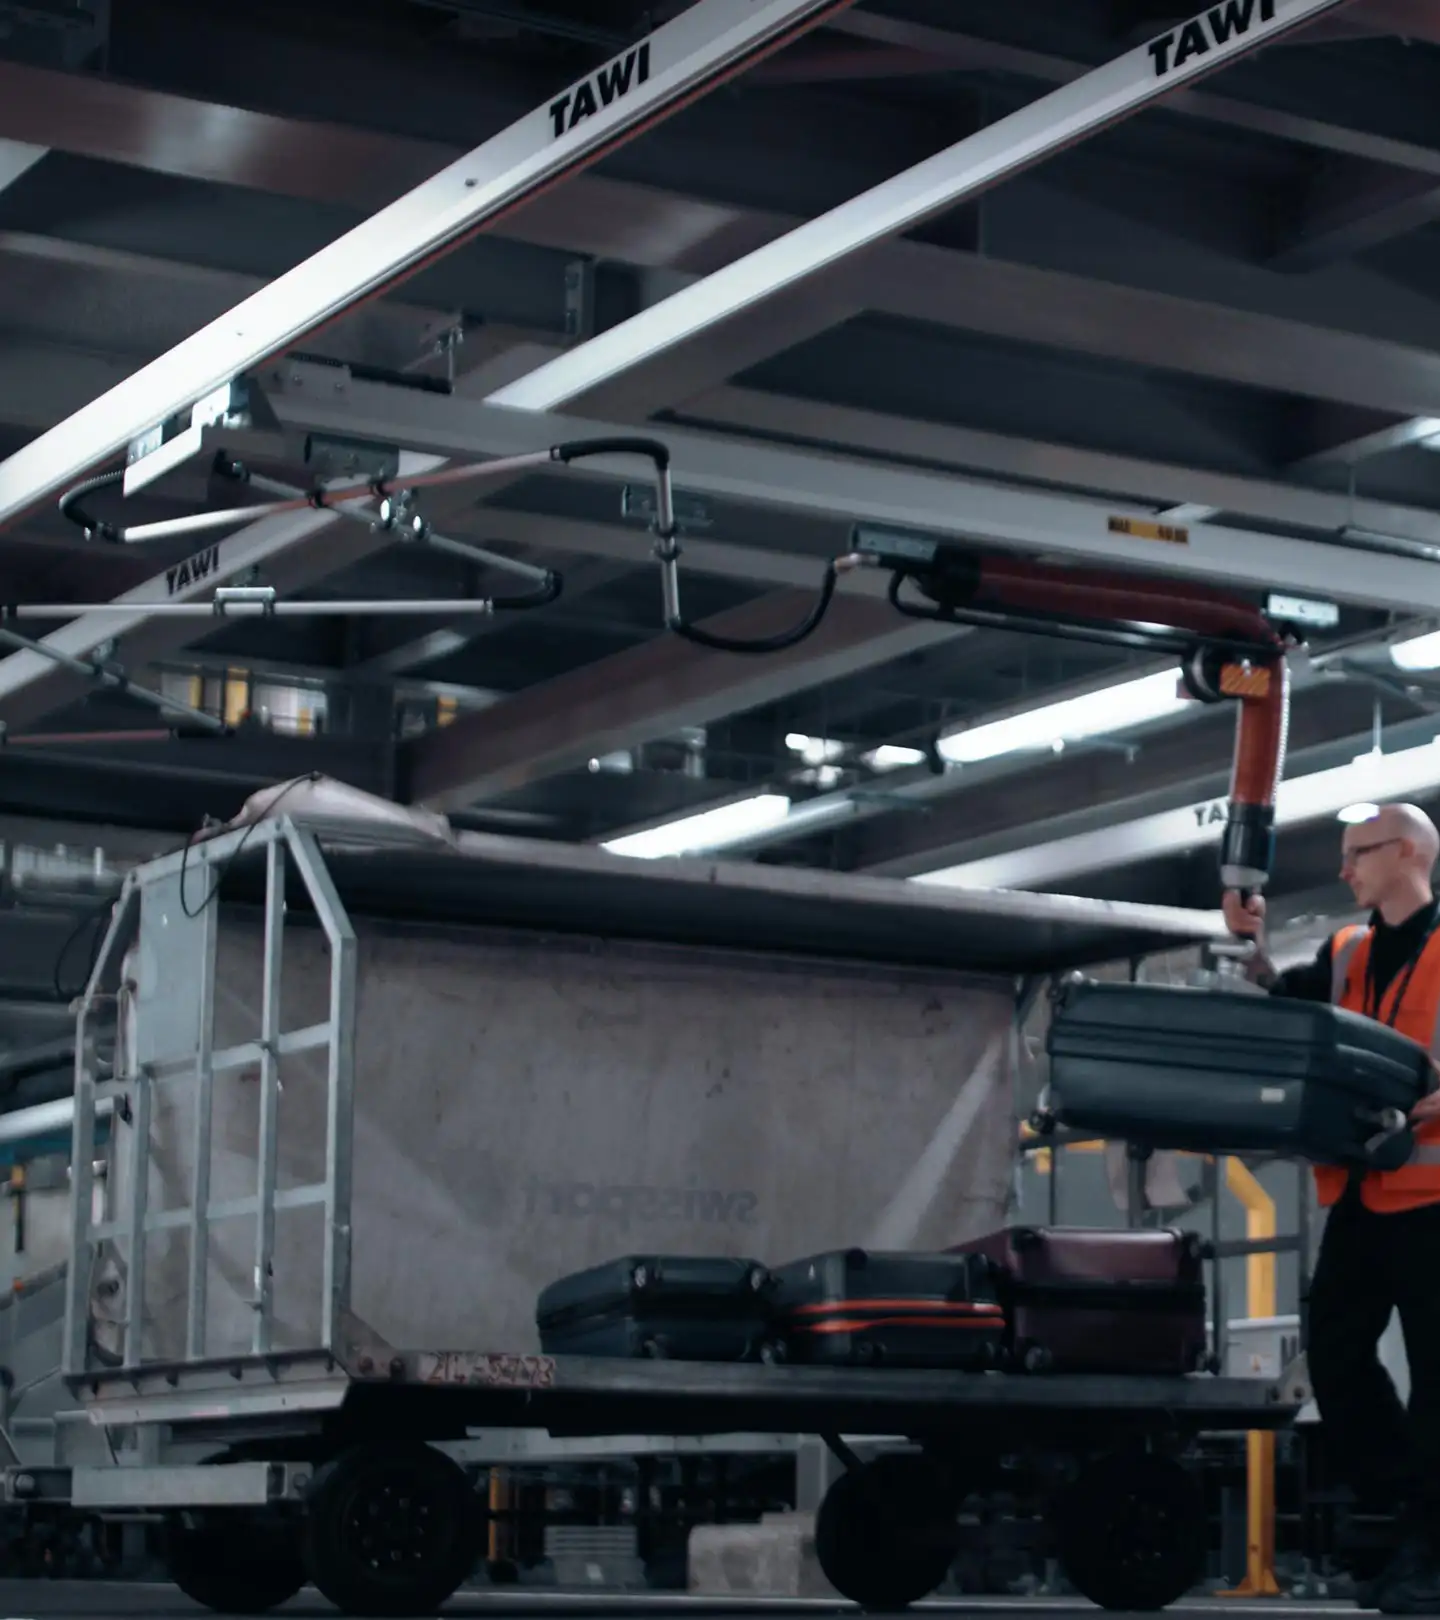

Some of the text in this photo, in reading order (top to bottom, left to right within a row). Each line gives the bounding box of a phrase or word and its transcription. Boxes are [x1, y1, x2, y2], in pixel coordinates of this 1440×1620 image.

[549, 41, 650, 139] TAWI
[166, 544, 219, 597] TAWI
[1193, 802, 1227, 827] TA
